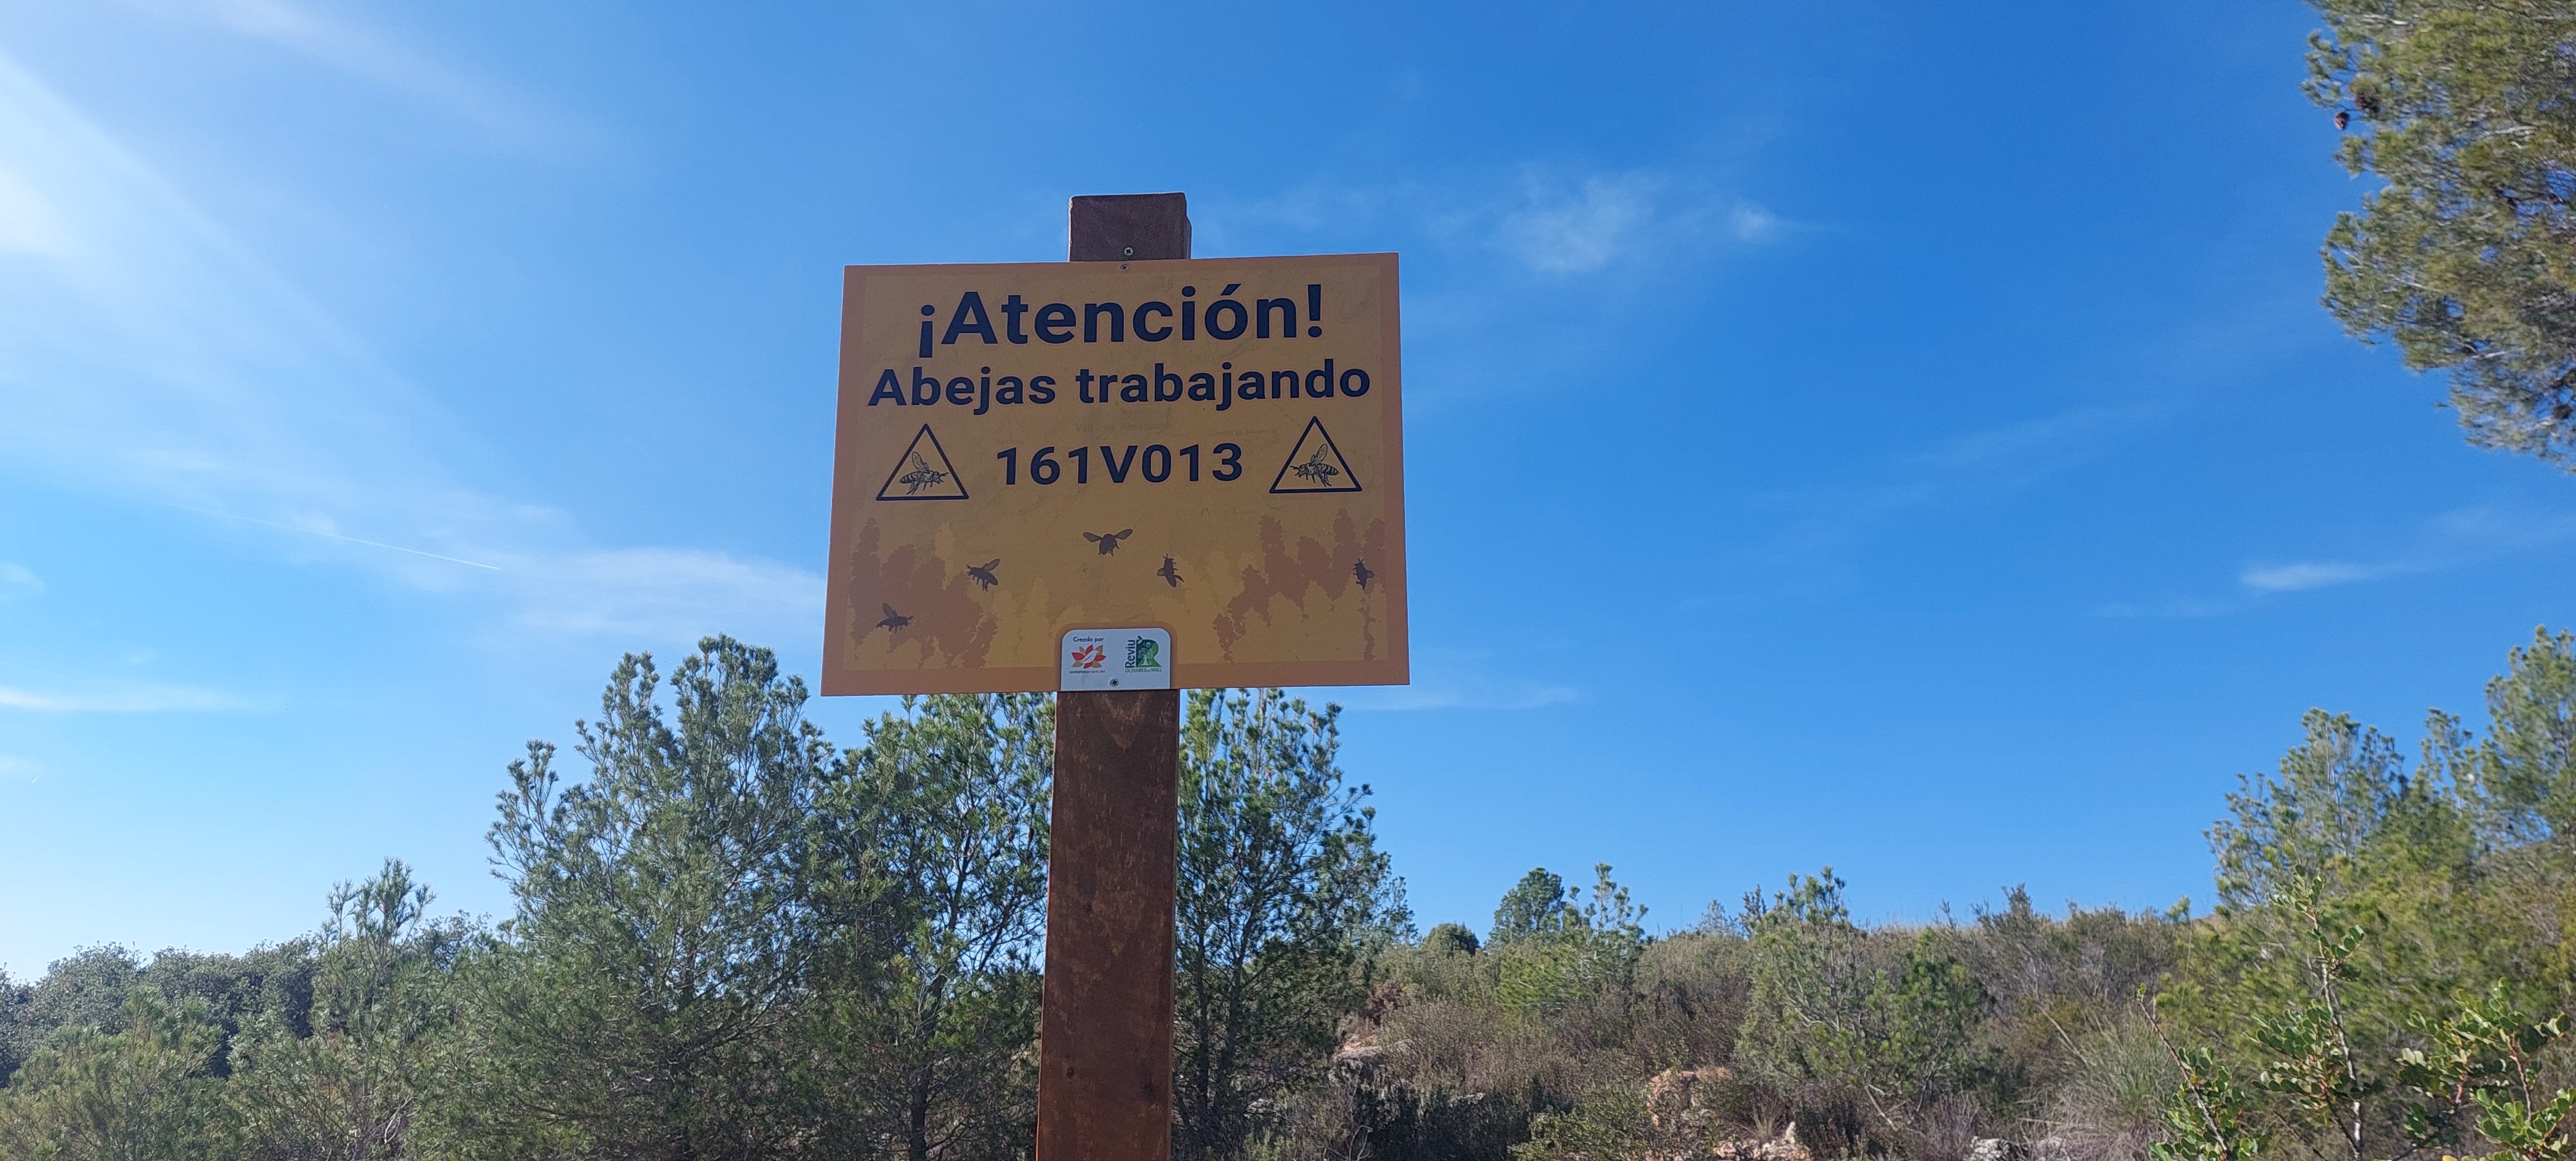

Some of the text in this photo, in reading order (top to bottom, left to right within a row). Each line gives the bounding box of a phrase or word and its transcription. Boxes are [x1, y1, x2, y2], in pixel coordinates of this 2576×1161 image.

[918, 283, 1323, 359] ¡Atención!
[867, 358, 1370, 416] Abejas trabajando
[996, 442, 1243, 486] 161V013
